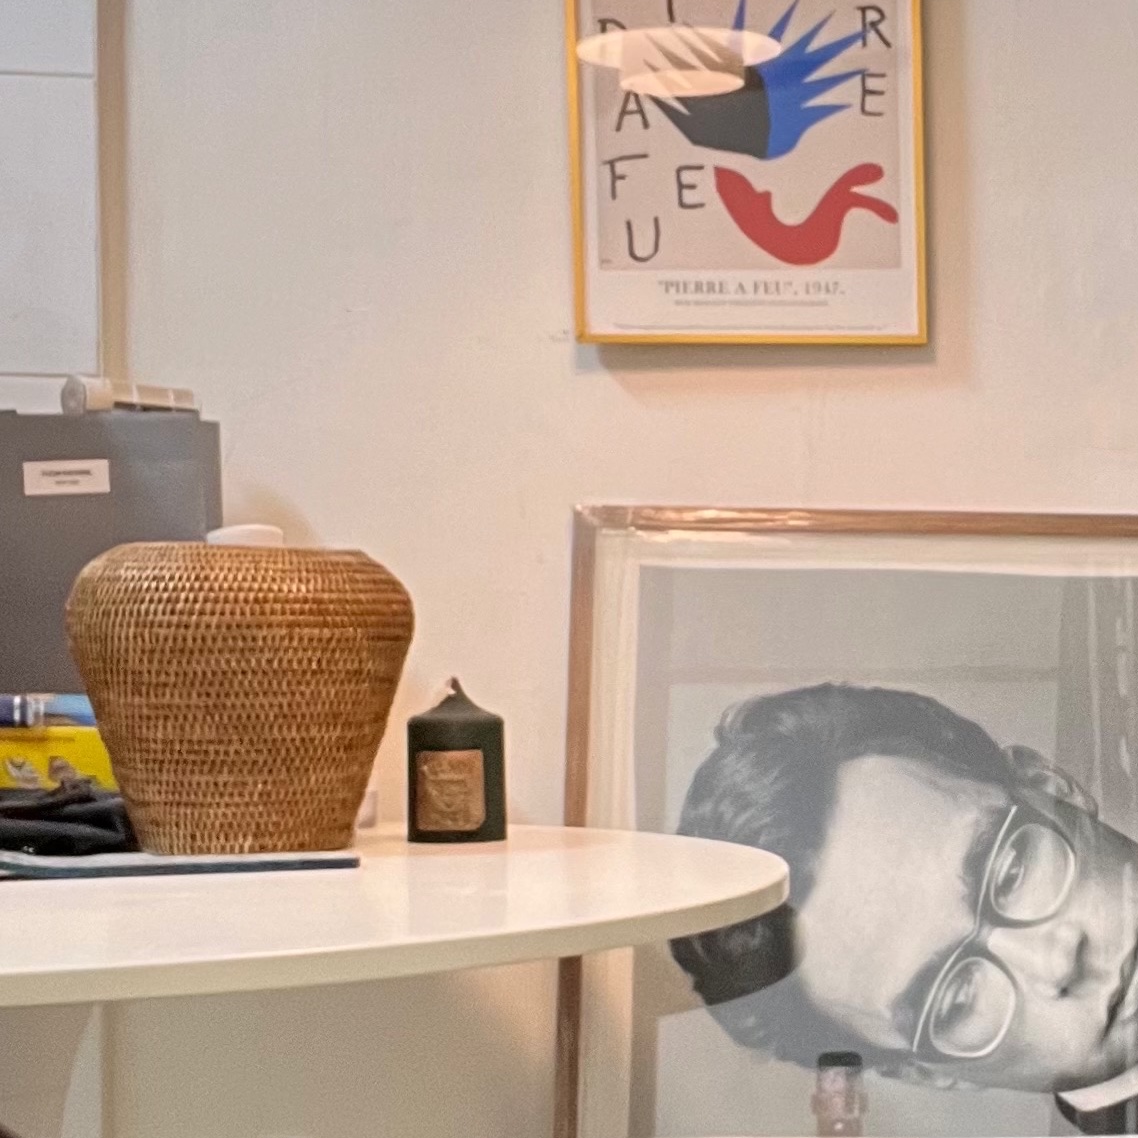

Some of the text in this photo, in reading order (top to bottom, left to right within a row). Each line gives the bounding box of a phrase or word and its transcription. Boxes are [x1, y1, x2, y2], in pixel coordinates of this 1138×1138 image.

[856, 5, 892, 49] R
[615, 90, 650, 132] A
[859, 73, 887, 117] E
[602, 153, 649, 200] F
[675, 165, 705, 209] E
[626, 216, 660, 262] U
